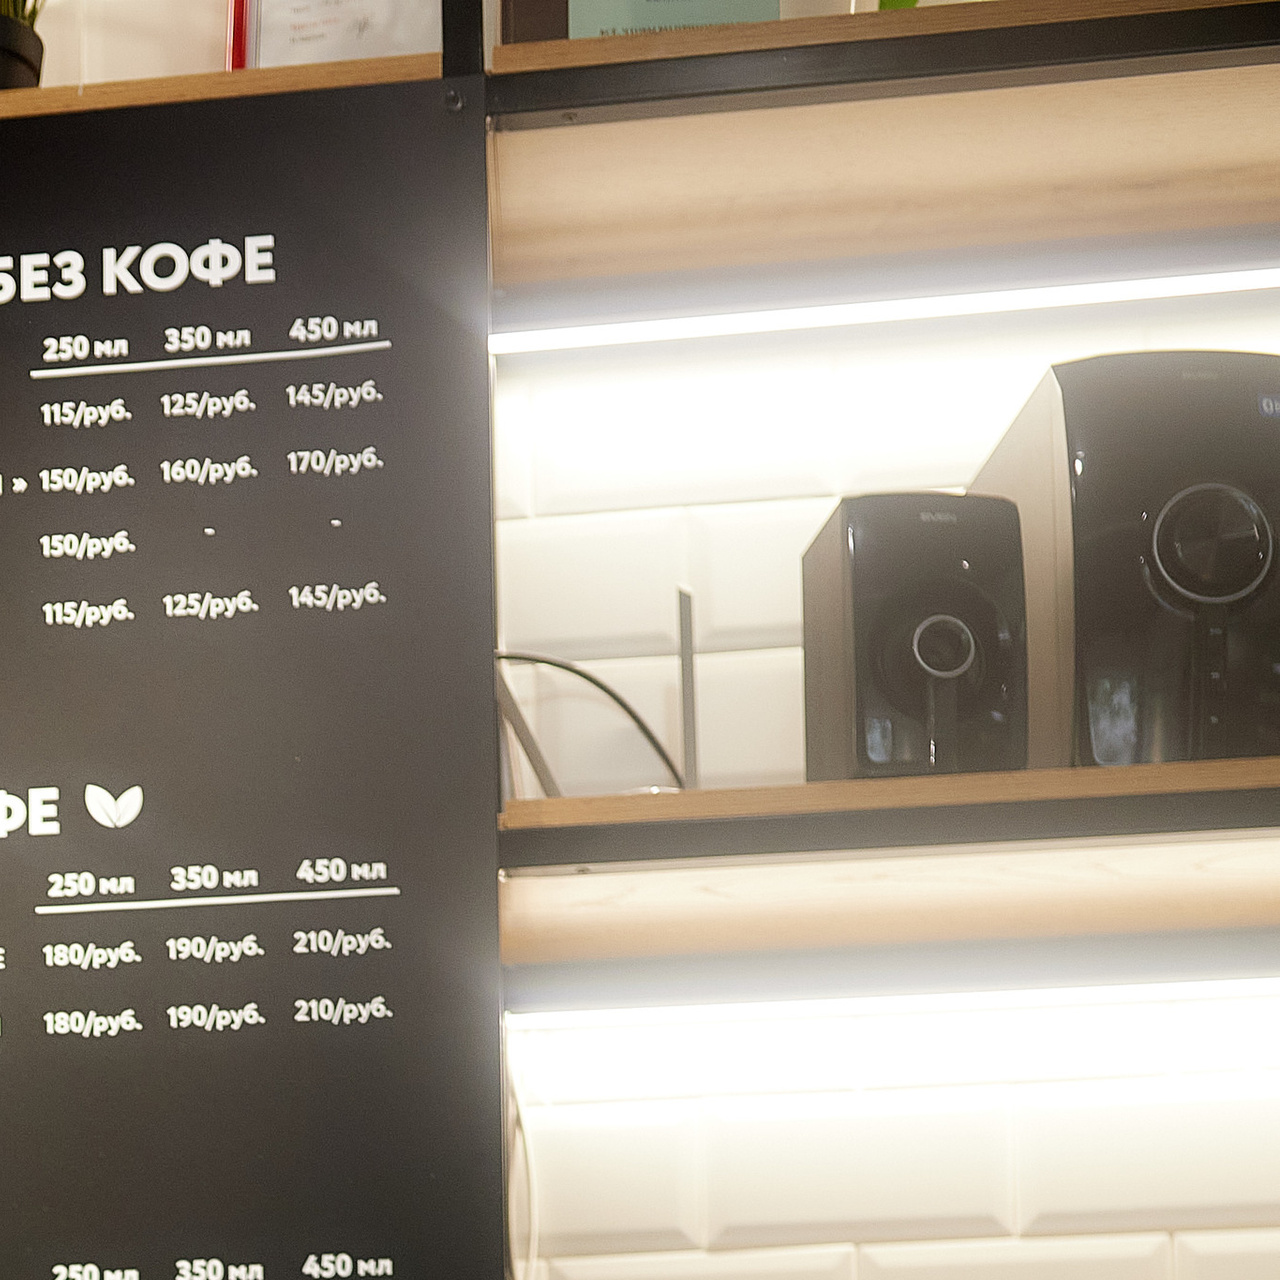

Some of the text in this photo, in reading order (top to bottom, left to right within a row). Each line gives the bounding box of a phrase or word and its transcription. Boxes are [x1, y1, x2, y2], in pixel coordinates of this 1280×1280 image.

[103, 235, 275, 295] КОФЕ
[43, 316, 377, 362] 250 мл 350 мл 450 мл
[41, 399, 132, 428] 115/руб.
[161, 390, 256, 418] 125/руб.
[286, 380, 383, 409] 145/руб.
[39, 465, 135, 494] 150/руб.
[160, 456, 257, 485] 160/руб.
[287, 447, 383, 476] 170/руб.
[40, 531, 135, 560] 150/руб.
[43, 599, 134, 627] 115/руб.
[163, 590, 258, 619] 125/руб.
[289, 582, 386, 611] 145/руб.
[48, 858, 386, 897] 250 мл 350 мл 450 мл
[43, 941, 141, 969] 180/руб.
[166, 935, 264, 963] 190/руб.
[293, 928, 391, 956] 210/руб.
[43, 1009, 142, 1037] 180/руб.
[167, 1003, 265, 1031] 190/руб.
[294, 996, 393, 1025] 210/руб.
[302, 1253, 352, 1278] 450
[357, 1259, 392, 1276] мл
